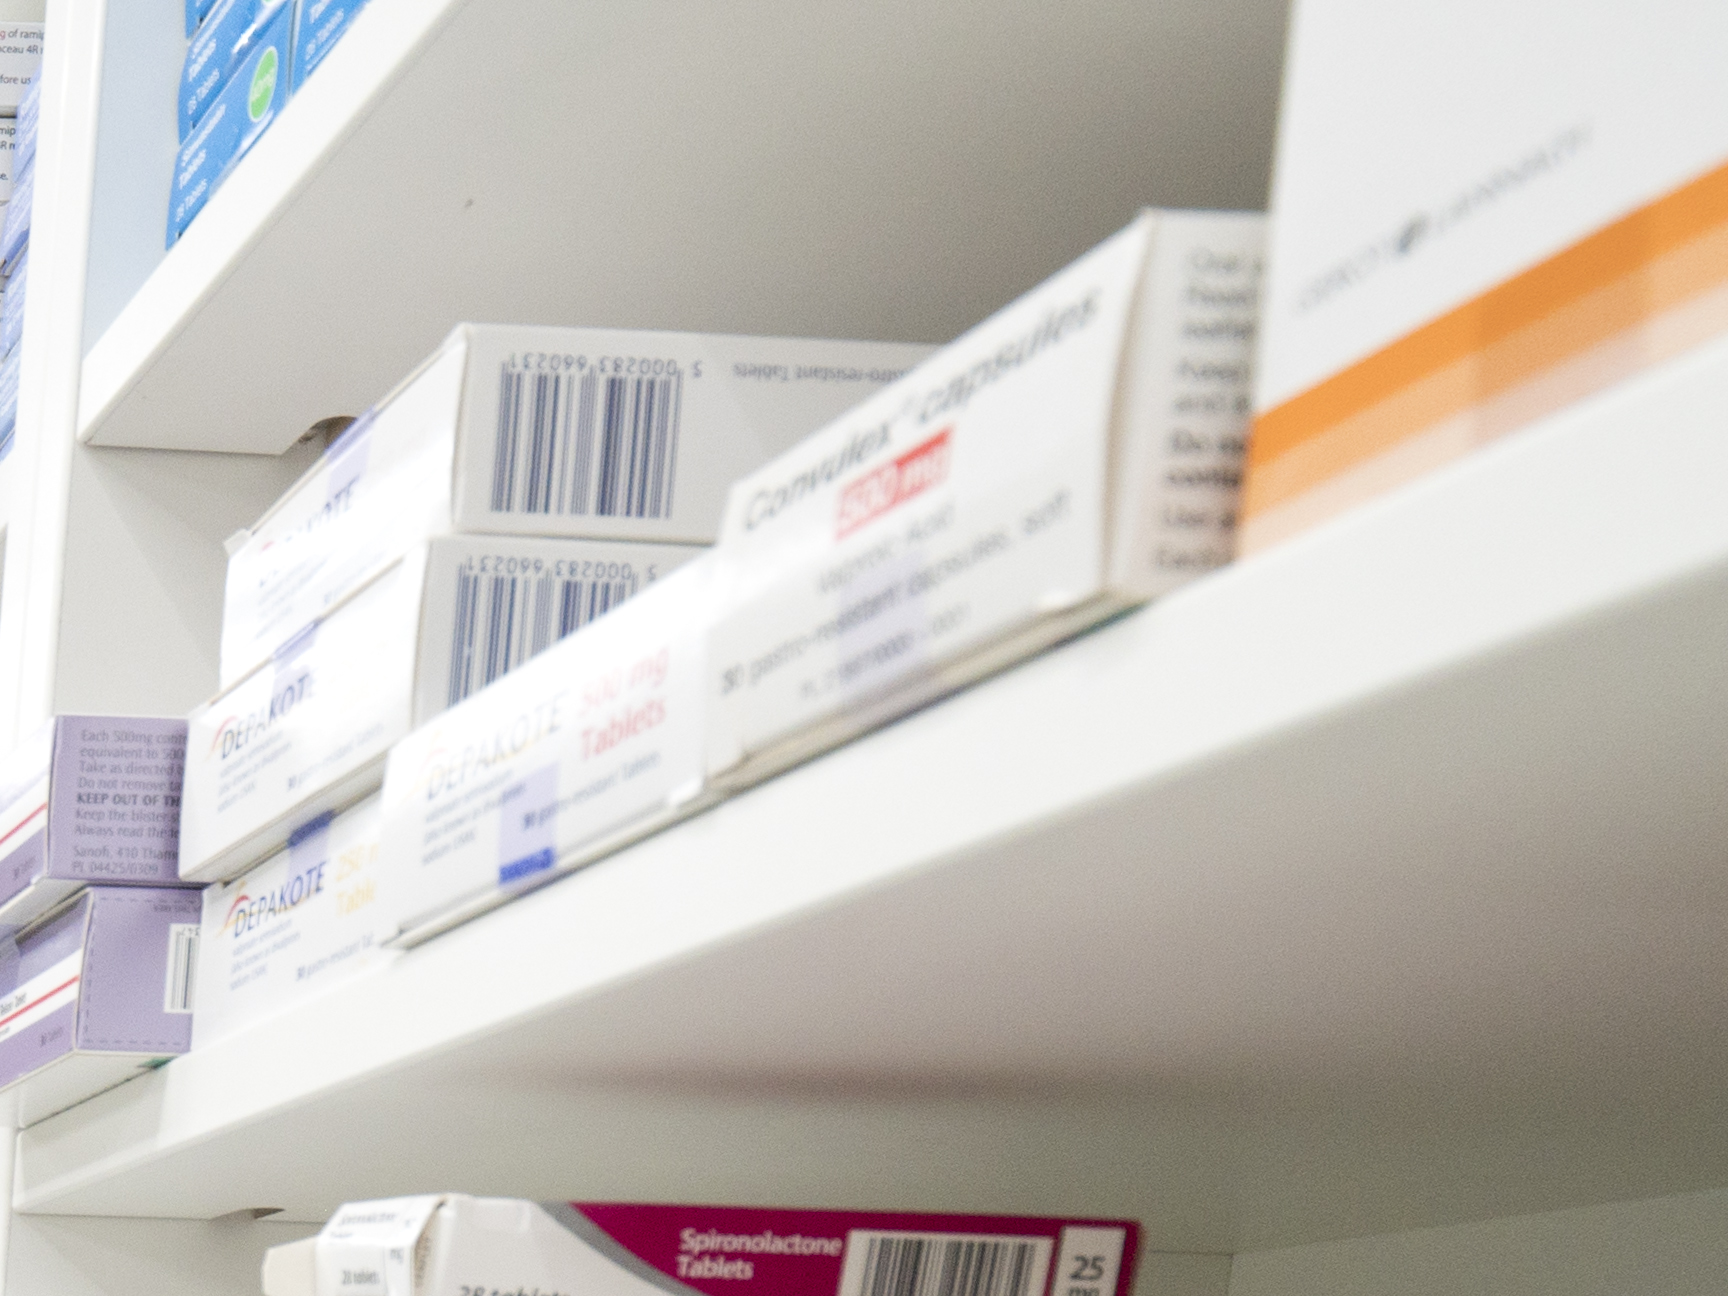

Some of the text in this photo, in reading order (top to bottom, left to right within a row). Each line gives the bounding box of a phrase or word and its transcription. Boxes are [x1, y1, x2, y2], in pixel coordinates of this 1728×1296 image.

[8, 28, 18, 38] of
[26, 45, 38, 54] 4R
[20, 77, 32, 85] us
[508, 352, 677, 378] 000283 660231
[81, 730, 109, 742] Each
[79, 760, 106, 773] Take
[110, 762, 122, 773] as
[78, 776, 164, 790] Do not remove
[77, 792, 158, 805] KEEP OUT OF
[76, 808, 126, 822] Keep the
[75, 823, 166, 837] Always read the
[234, 861, 327, 939] DEPAKOTE
[678, 1228, 843, 1259] Spironolactone
[676, 1255, 754, 1281] Tablets
[1068, 1255, 1105, 1281] 25
